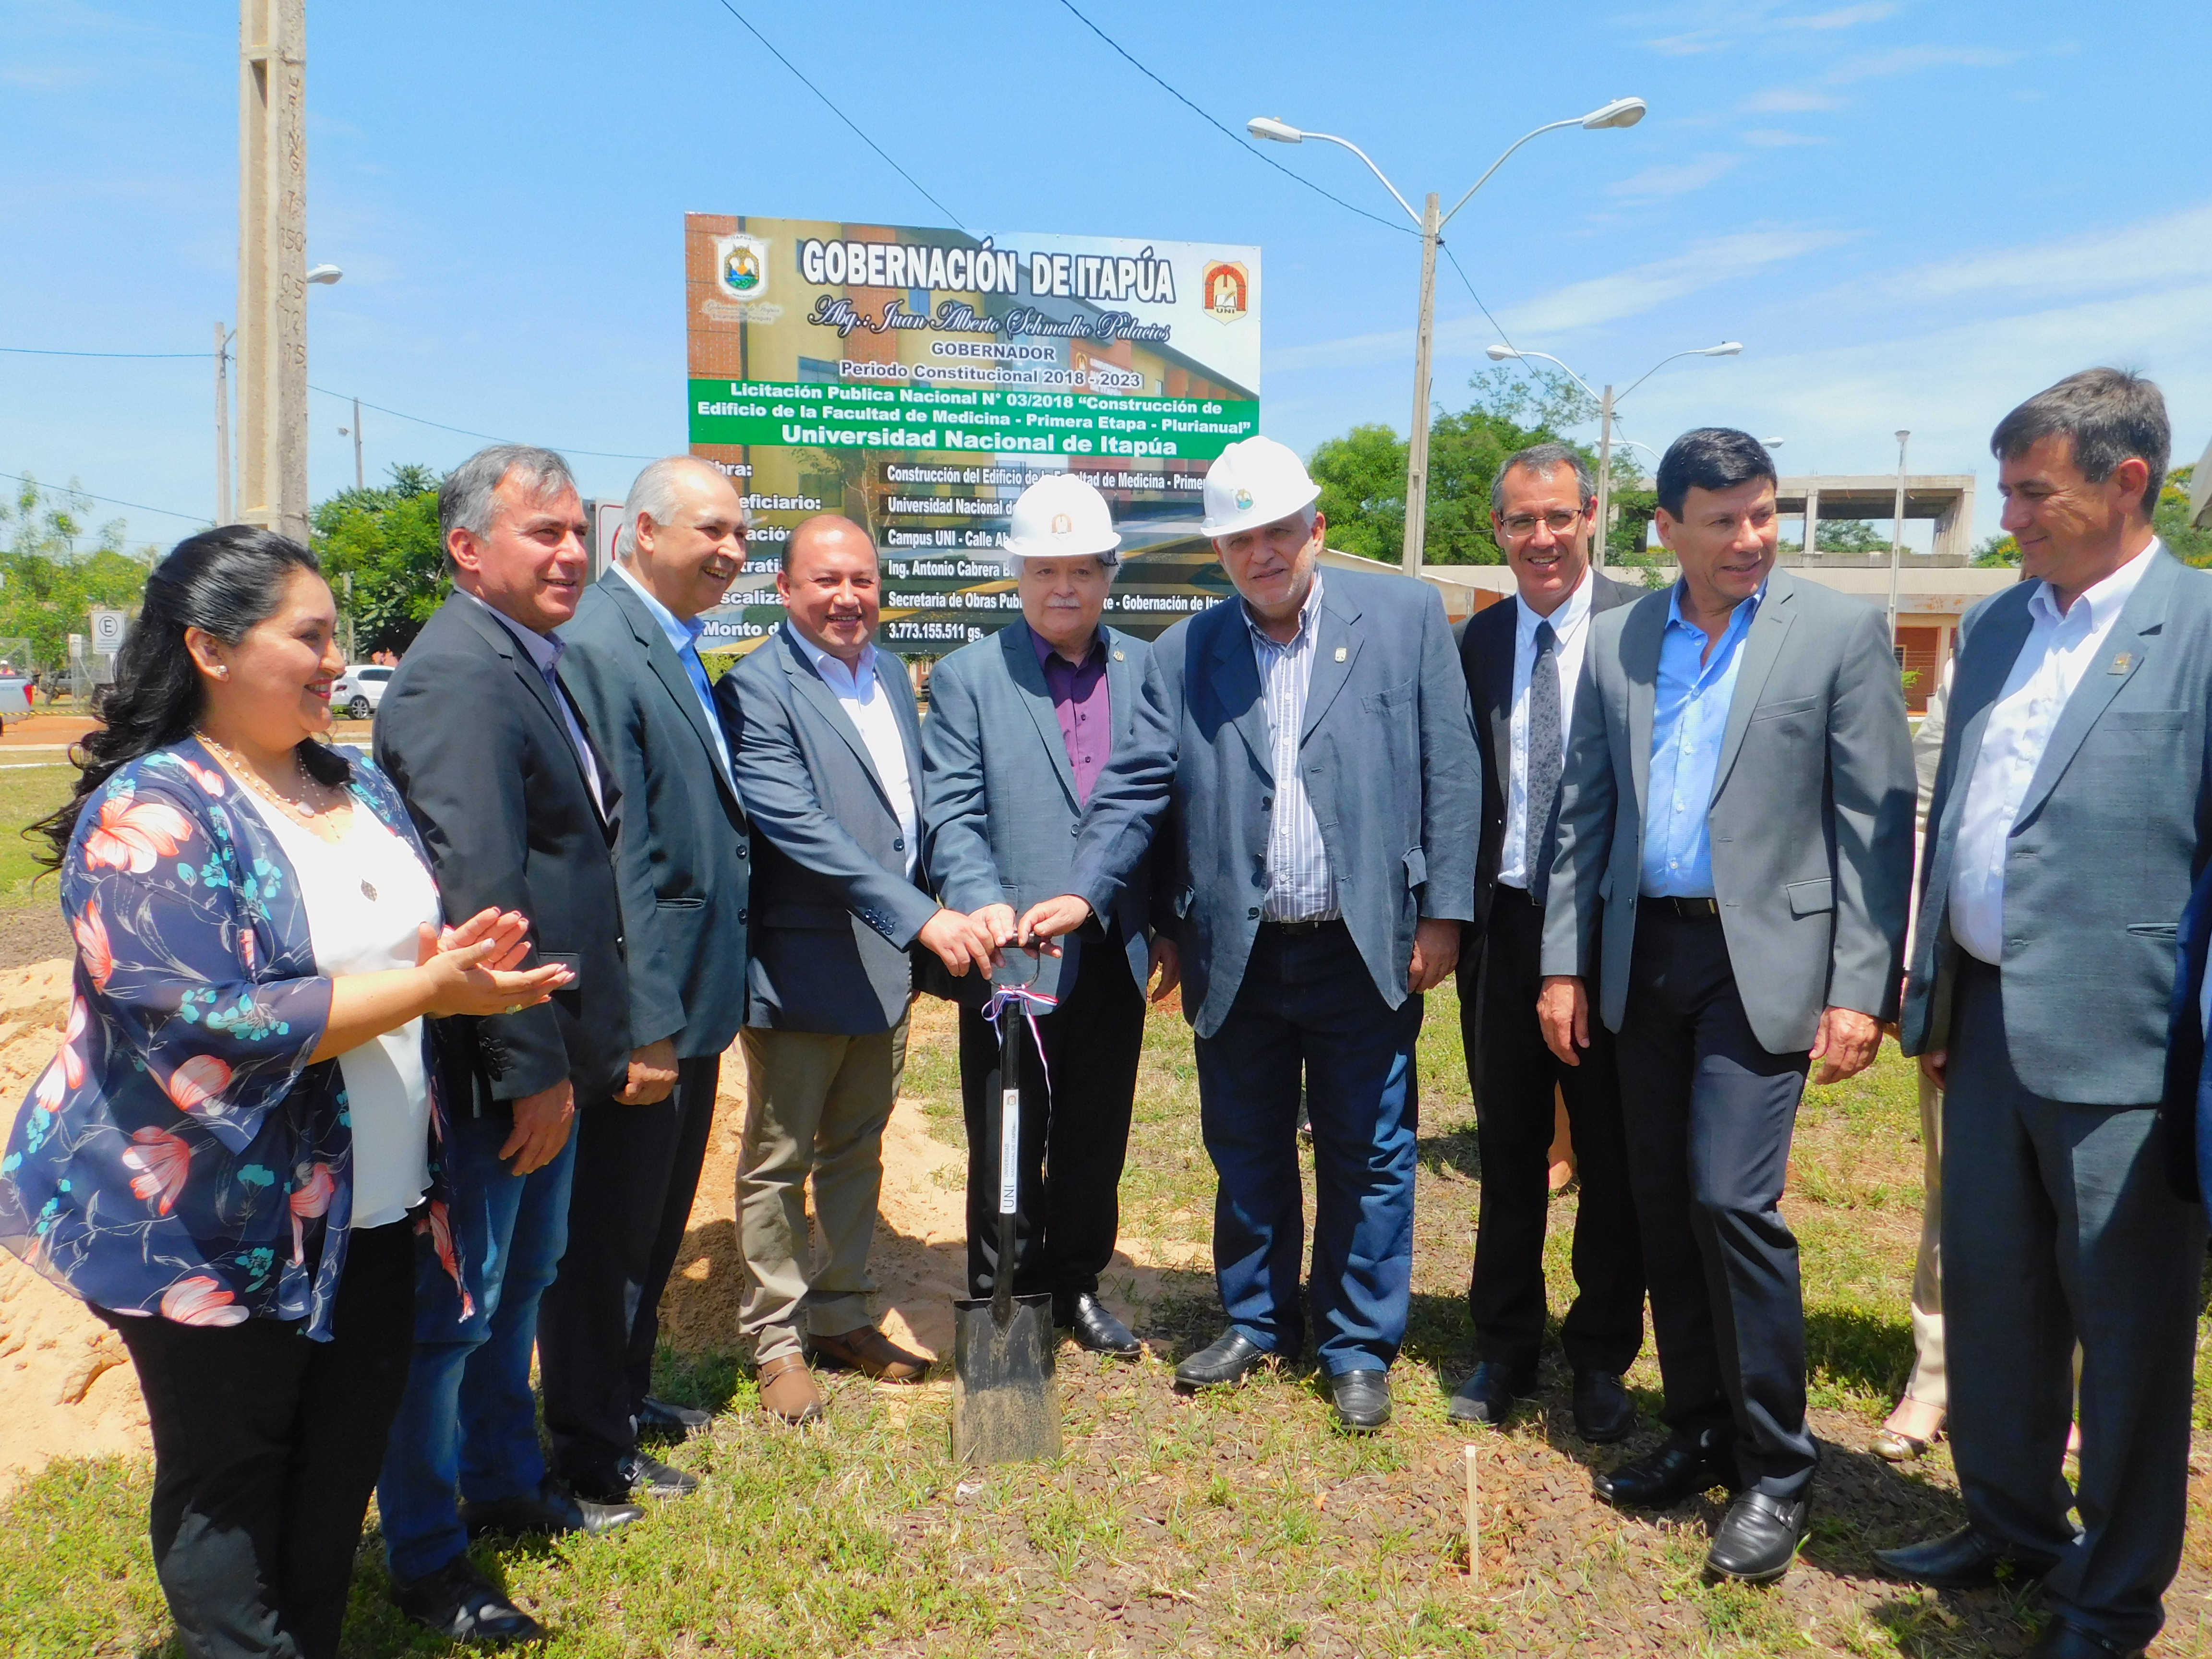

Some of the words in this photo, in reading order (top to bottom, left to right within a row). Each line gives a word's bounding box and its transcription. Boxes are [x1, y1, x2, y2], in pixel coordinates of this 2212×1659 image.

[802, 237, 1017, 294] GOBERNACIÓN
[1032, 254, 1071, 296] DE
[1077, 248, 1175, 302] ITAPÚA
[871, 300, 927, 333] Juan
[930, 301, 1001, 333] Alberto
[1008, 308, 1093, 338] Schmalko
[1097, 312, 1170, 340] Palacios
[931, 342, 1055, 360] GOBERNADOR
[842, 361, 907, 376] Periodo
[914, 365, 1037, 382] Constitucional
[1043, 371, 1084, 384] 2018
[1100, 373, 1140, 386] 2023
[731, 383, 822, 399] Licitación
[828, 386, 895, 401] Publica
[900, 388, 977, 405] Nacional
[982, 392, 1001, 406] N°
[1006, 393, 1073, 408] 03/2018
[1202, 401, 1222, 414] de
[697, 401, 767, 416] Edificio
[772, 404, 795, 418] de
[800, 405, 816, 418] la
[823, 406, 900, 421] Facultad
[905, 409, 927, 422] de
[933, 410, 1010, 425] Medicina
[1026, 413, 1093, 428] Primera
[1098, 416, 1146, 432] Etapa
[782, 424, 936, 446] Universidad
[945, 430, 1055, 451] Nacional
[1062, 434, 1093, 452] de
[1101, 435, 1177, 457] Itapúa
[714, 460, 752, 476] bra:
[887, 465, 960, 482] Construcción
[963, 467, 979, 483] del
[982, 468, 1022, 484] Edificio
[1025, 469, 1038, 485] de
[1102, 471, 1115, 487] de
[1118, 472, 1165, 489] Medicina
[888, 496, 952, 513] Universidad
[956, 498, 1003, 515] Nacional
[888, 529, 932, 548] Campus
[936, 530, 955, 546] UNI
[965, 531, 992, 547] Calle
[740, 558, 782, 573] trati
[889, 560, 909, 579] Ing.
[912, 560, 954, 576] Antonio
[957, 561, 999, 577] Cabrera
[889, 591, 946, 607] Secretaria
[949, 592, 962, 607] de
[965, 592, 997, 608] Obras
[1122, 594, 1187, 610] Gobernación
[1190, 596, 1203, 610] de
[104, 619, 112, 633] E
[703, 622, 762, 636] Monto
[889, 623, 964, 639] 3.773.155.511
[967, 626, 984, 642] gs.
[1004, 1185, 1014, 1208] UNI
